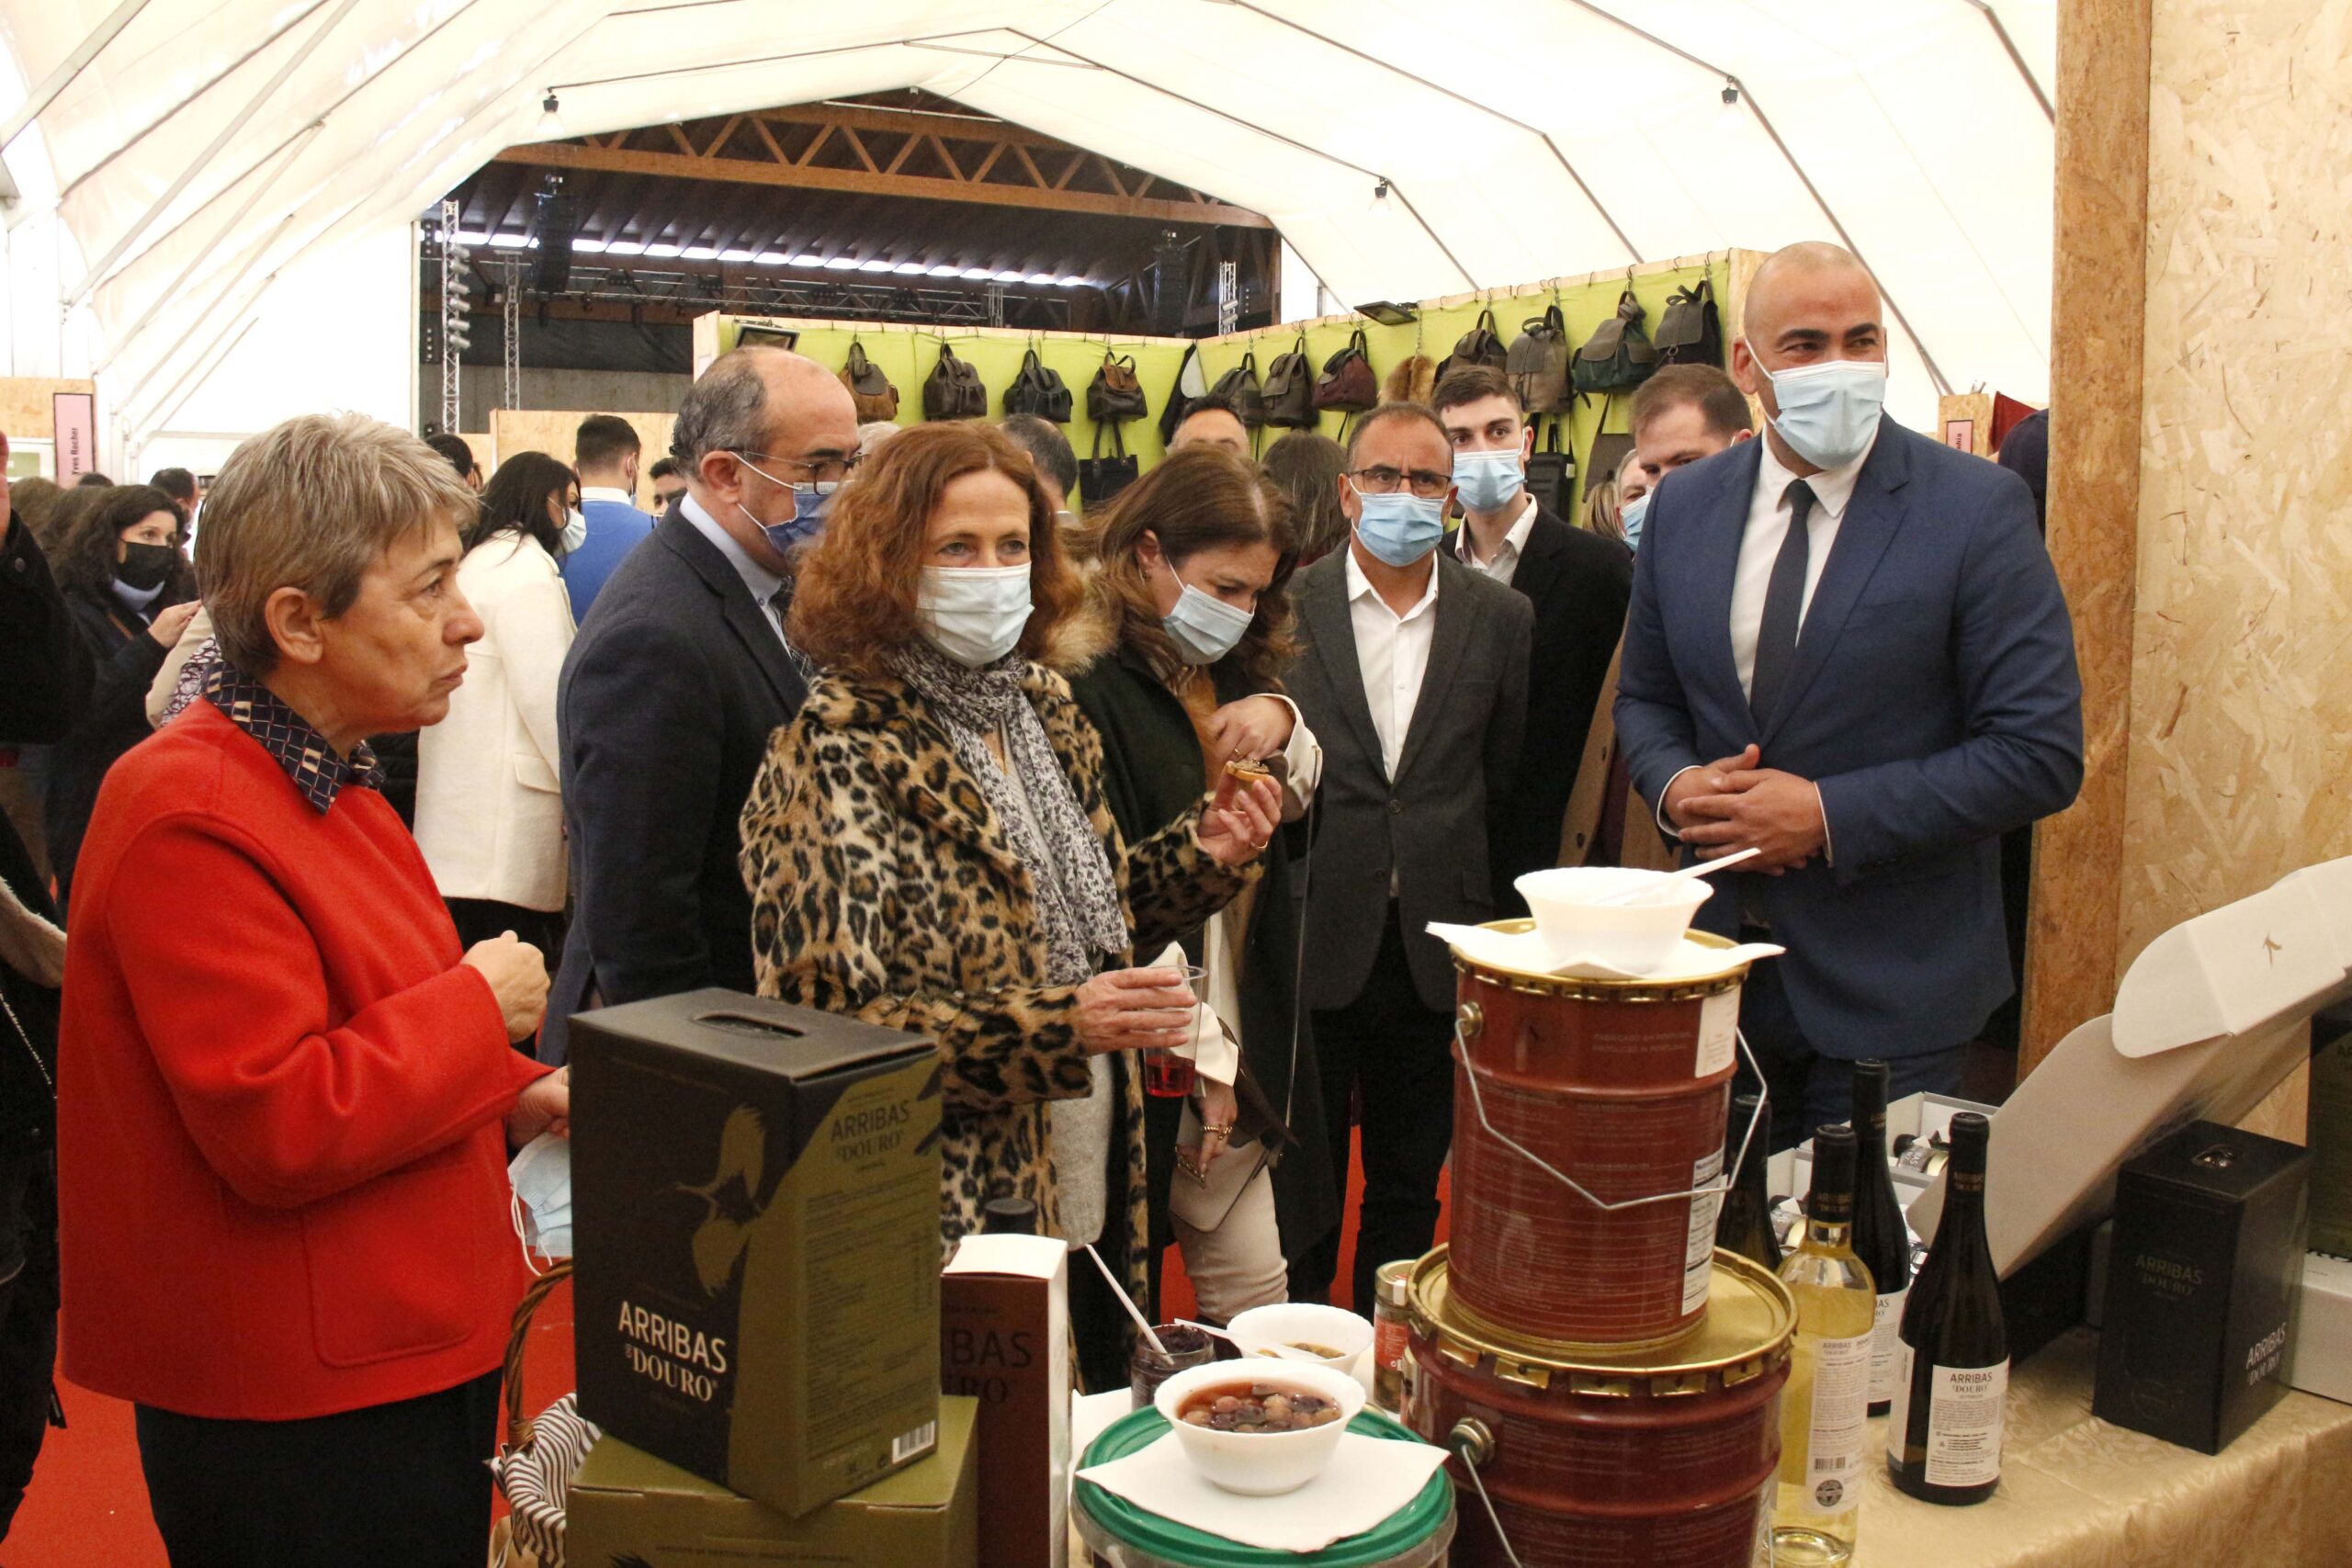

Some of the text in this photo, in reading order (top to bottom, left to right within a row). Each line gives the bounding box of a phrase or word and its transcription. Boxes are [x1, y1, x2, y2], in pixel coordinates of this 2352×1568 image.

[70, 428, 80, 475] Yves Rocher
[831, 1100, 910, 1142] ARRIBAS
[842, 1131, 901, 1161] DOURO
[2135, 1254, 2204, 1285] ARRIBAS
[618, 1301, 727, 1373] ARRIBAS
[2245, 1321, 2287, 1370] ARRIBAS
[633, 1346, 713, 1402] DOURO
[1950, 1371, 1993, 1384] ARRIBAS
[1954, 1383, 1987, 1393] DOURO
